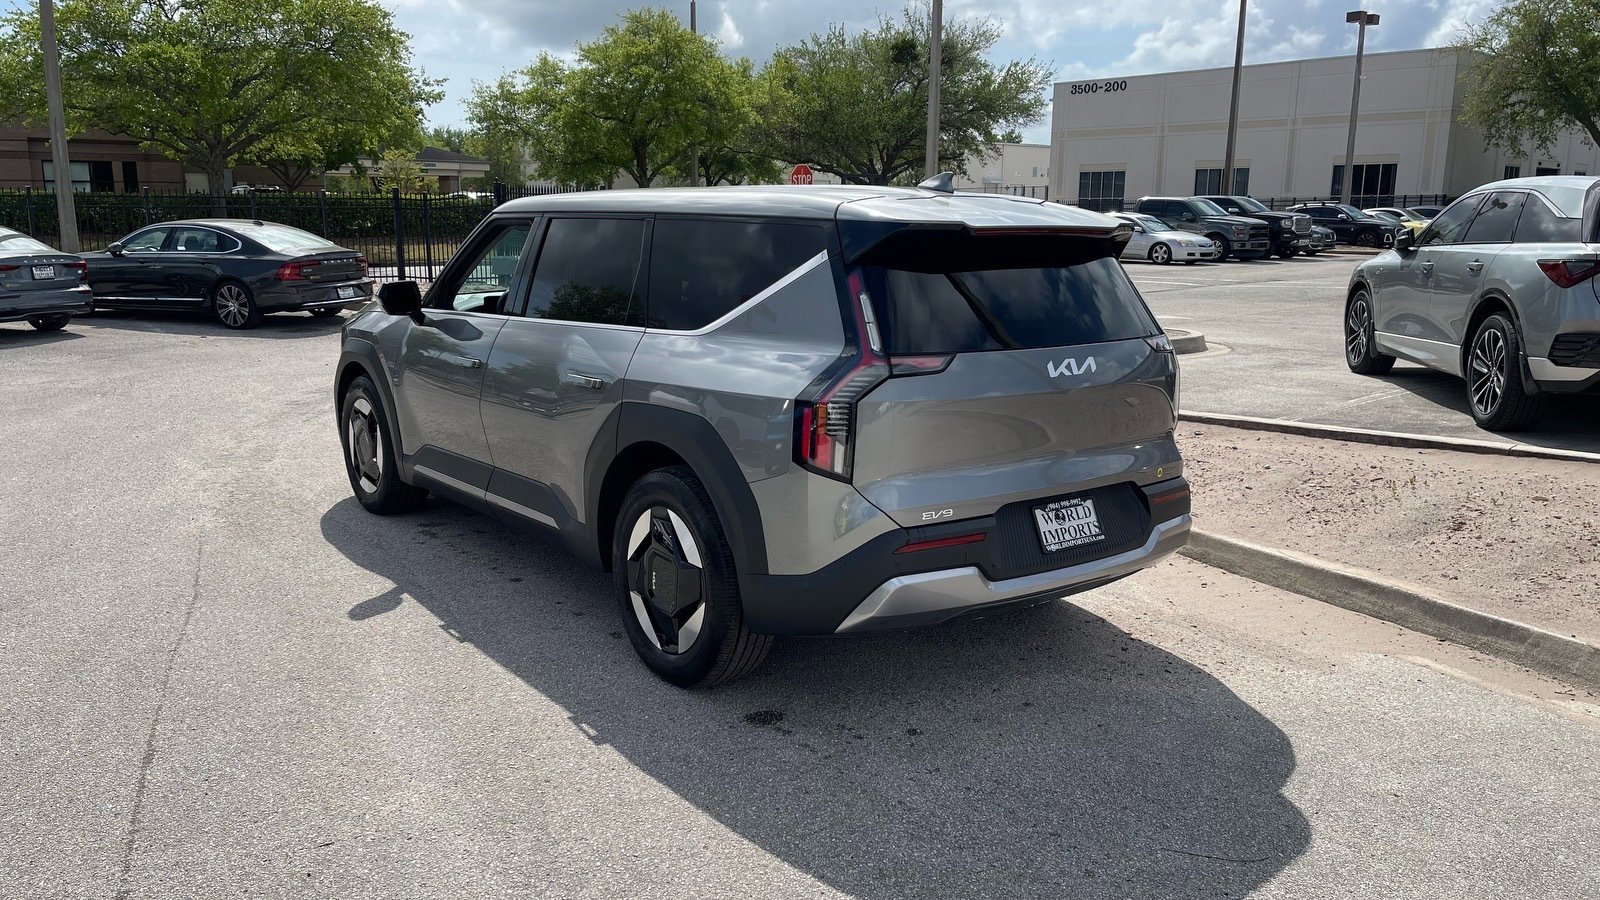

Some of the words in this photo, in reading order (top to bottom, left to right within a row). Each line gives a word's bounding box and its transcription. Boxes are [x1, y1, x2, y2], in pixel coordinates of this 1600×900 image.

[1071, 80, 1127, 94] 3500-200
[793, 174, 811, 185] STOP
[1047, 356, 1097, 378] KIA
[921, 508, 953, 520] EV9
[1041, 505, 1091, 526] WORLD
[1042, 520, 1101, 543] IMPORTS
